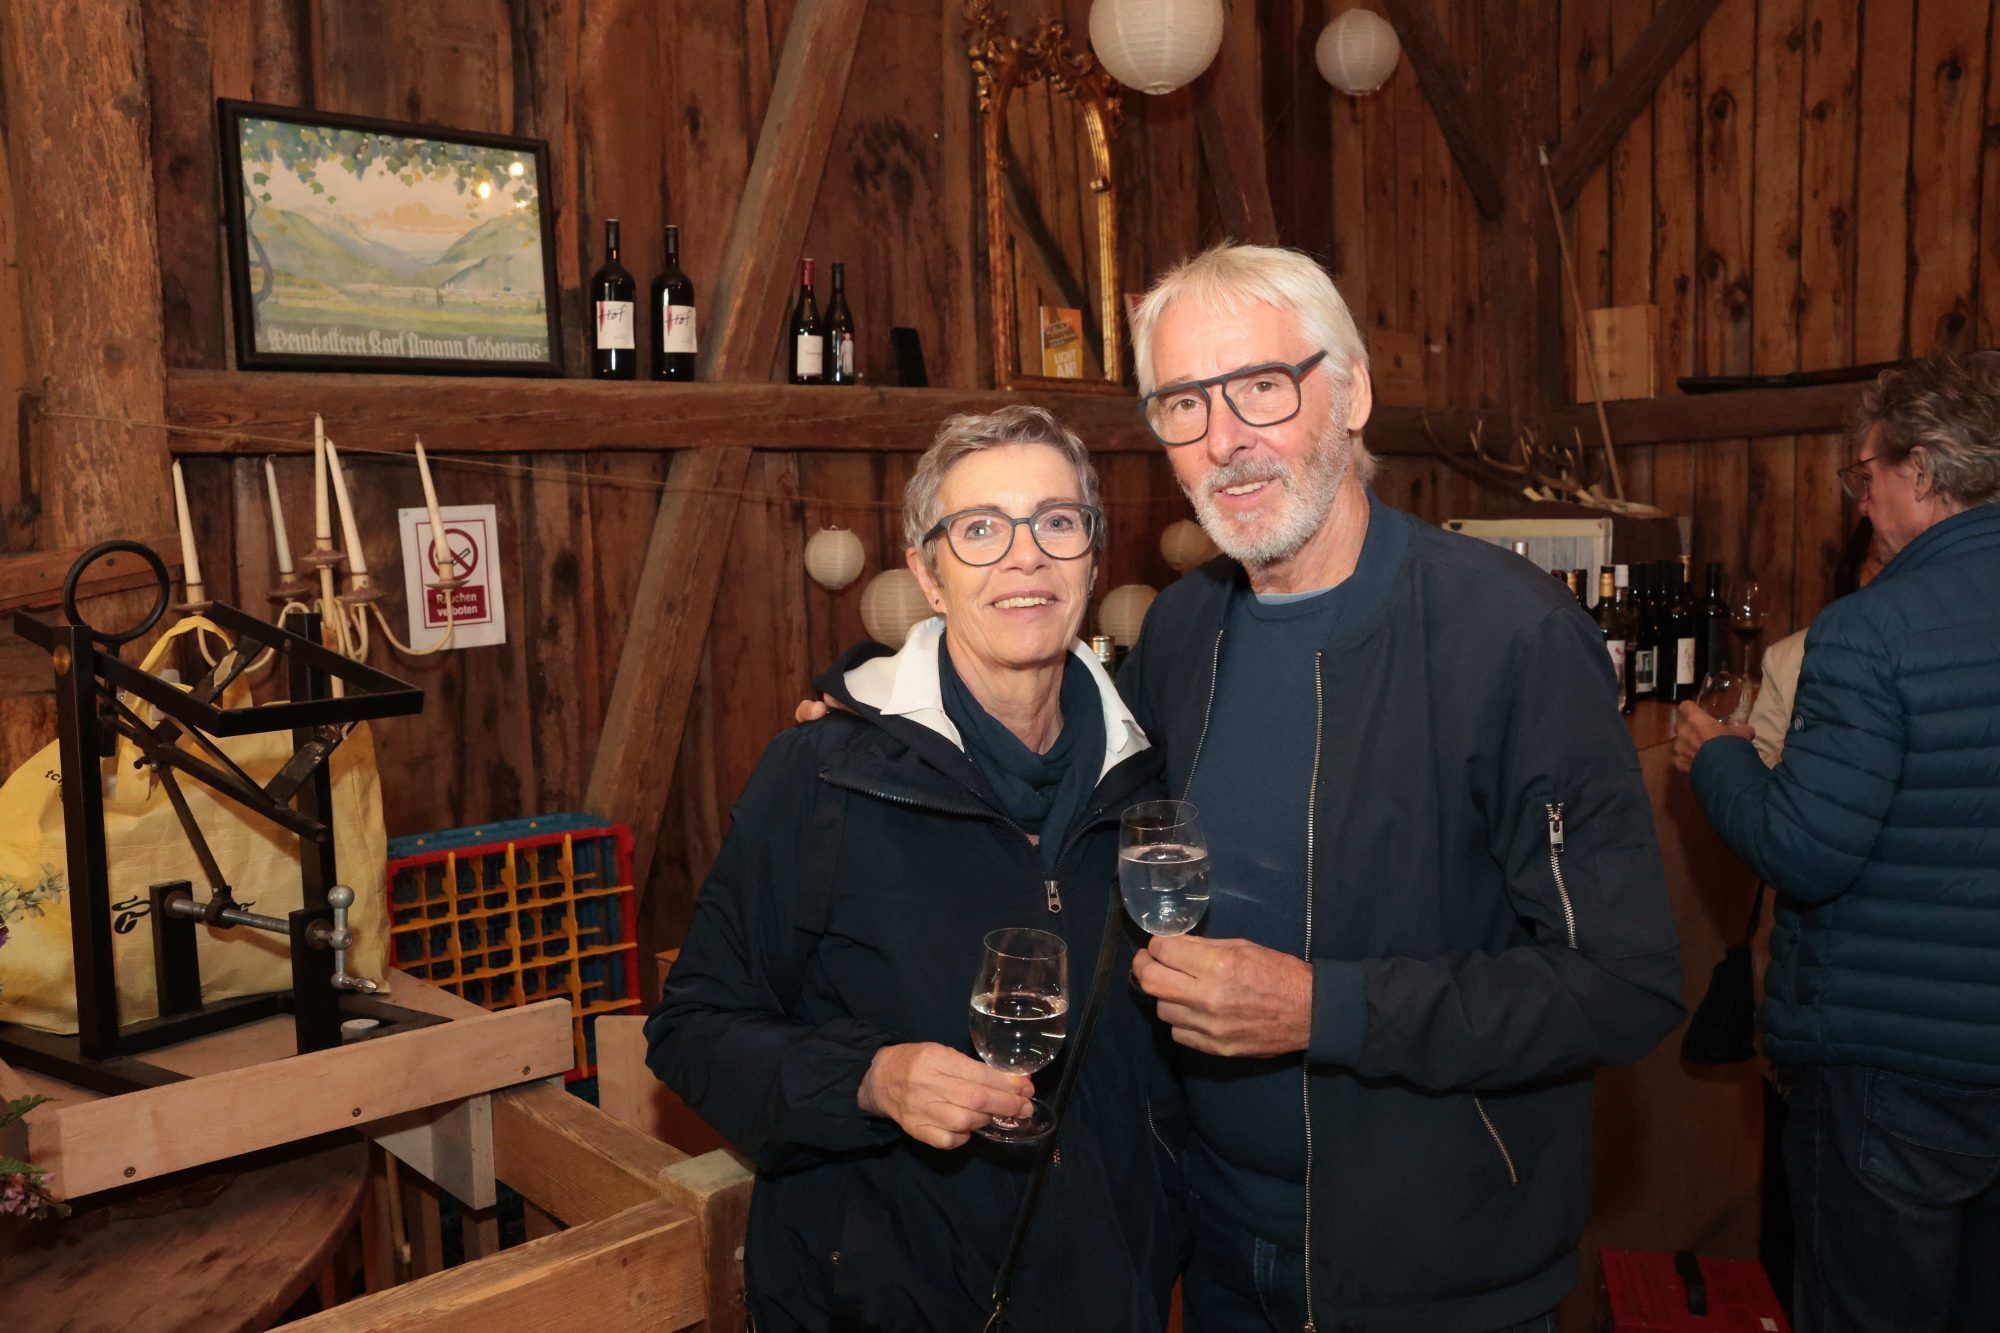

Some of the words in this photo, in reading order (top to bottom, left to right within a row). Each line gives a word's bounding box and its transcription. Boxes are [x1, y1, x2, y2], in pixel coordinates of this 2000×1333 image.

[369, 328, 406, 356] Karl
[436, 592, 476, 604] Ruchen
[437, 605, 477, 617] veboten
